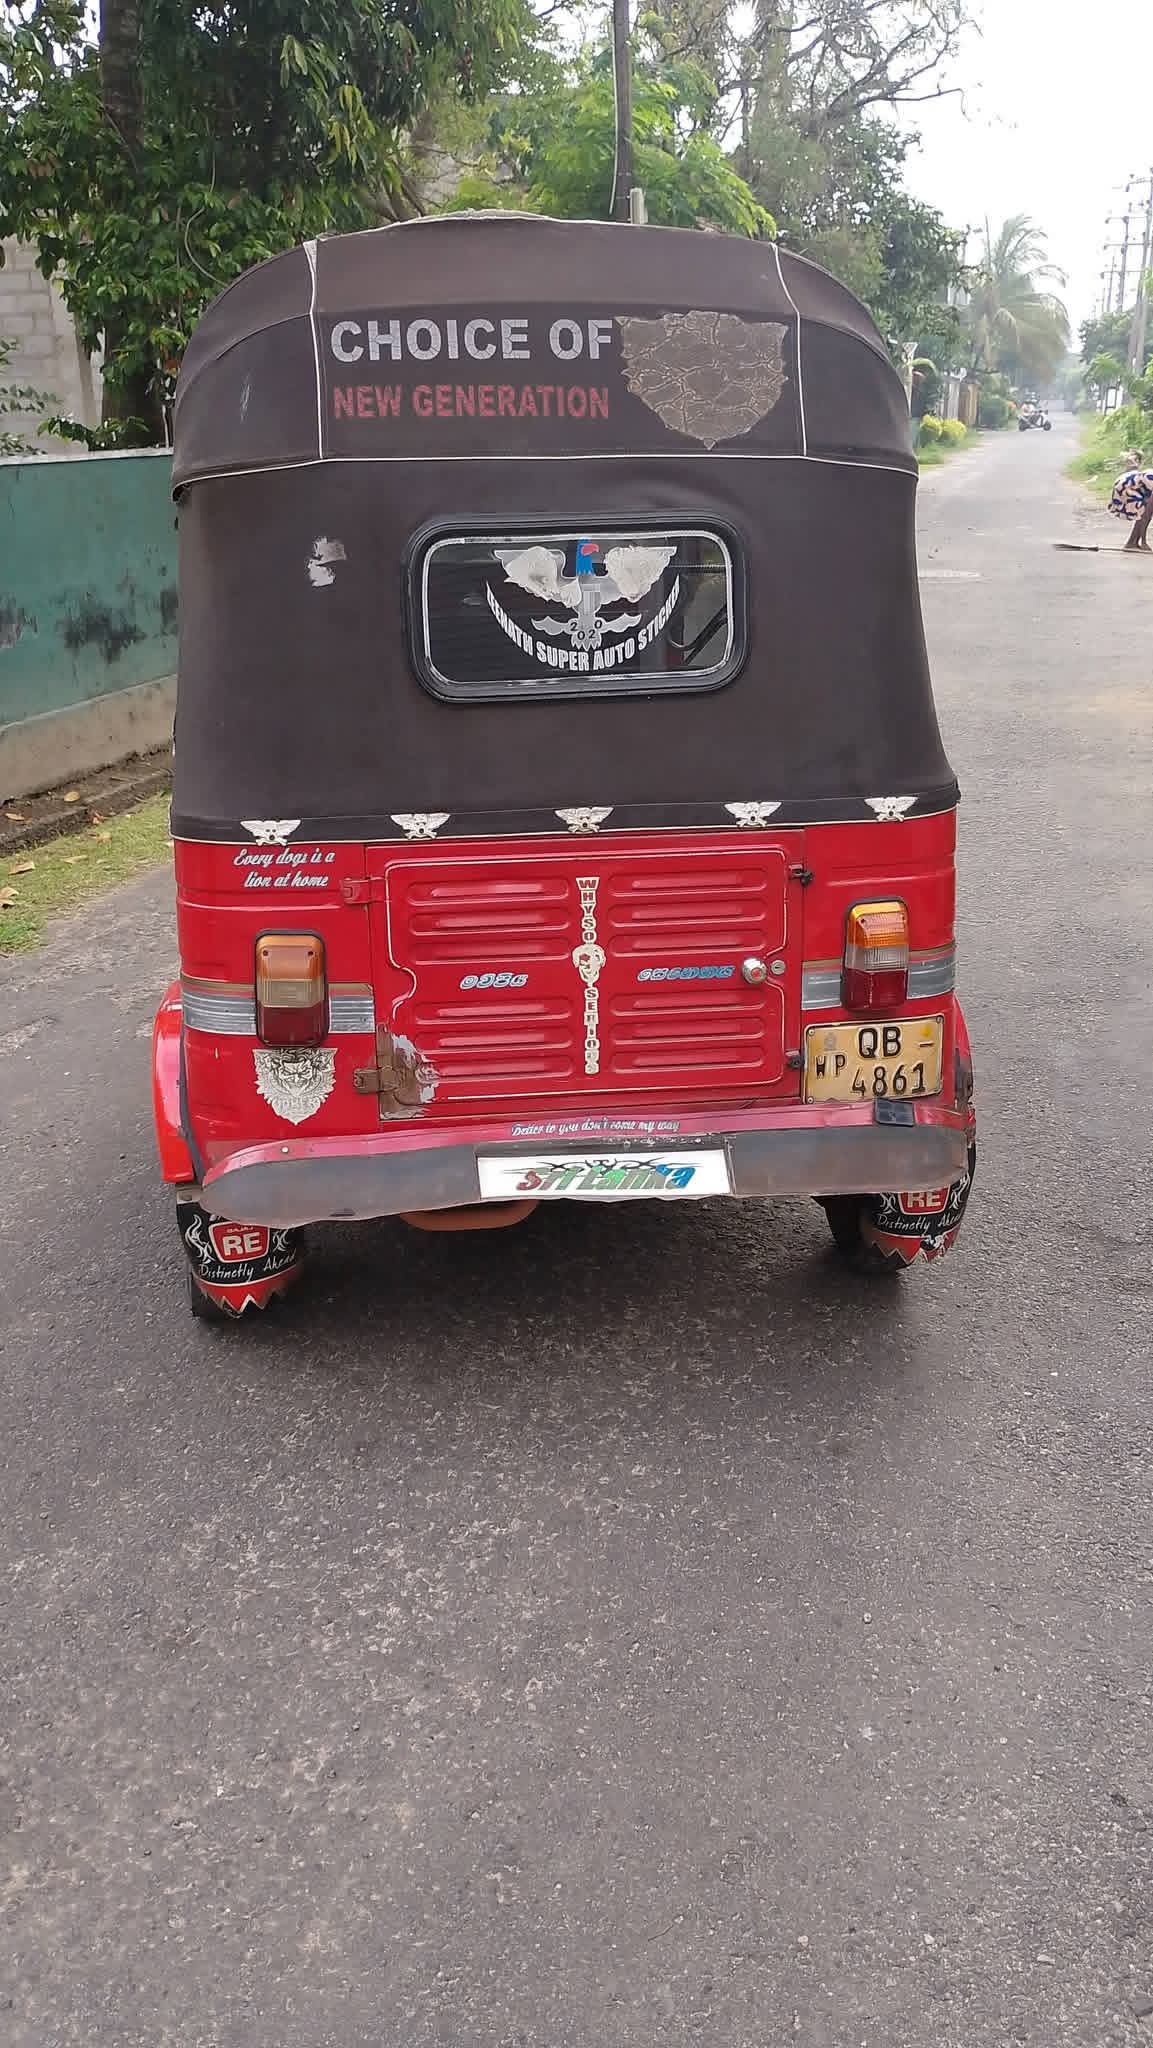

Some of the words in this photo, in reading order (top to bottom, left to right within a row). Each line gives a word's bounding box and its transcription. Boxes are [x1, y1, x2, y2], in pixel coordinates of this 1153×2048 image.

[331, 318, 531, 363] CHOICE
[549, 318, 613, 361] OF
[332, 385, 401, 419] NEW
[412, 384, 609, 418] GENERATION
[536, 641, 590, 671] SUPER
[593, 637, 635, 671] AUTO
[233, 848, 274, 868] Every
[275, 847, 308, 868] dogs
[310, 847, 323, 863] is
[325, 852, 336, 863] a
[274, 872, 291, 887] at
[291, 870, 329, 887] home
[858, 1026, 902, 1059] QB
[815, 1054, 846, 1078] WP
[851, 1062, 926, 1098] 4861
[545, 1123, 556, 1134] to
[559, 1122, 579, 1135] you
[610, 1120, 636, 1130] come
[638, 1121, 656, 1133] my
[657, 1120, 680, 1132] way
[907, 1190, 941, 1208] RE
[878, 1214, 932, 1236] Distinctly
[222, 1232, 263, 1256] RE
[200, 1263, 255, 1283] Distinctly
[263, 1247, 297, 1272] Ahead
